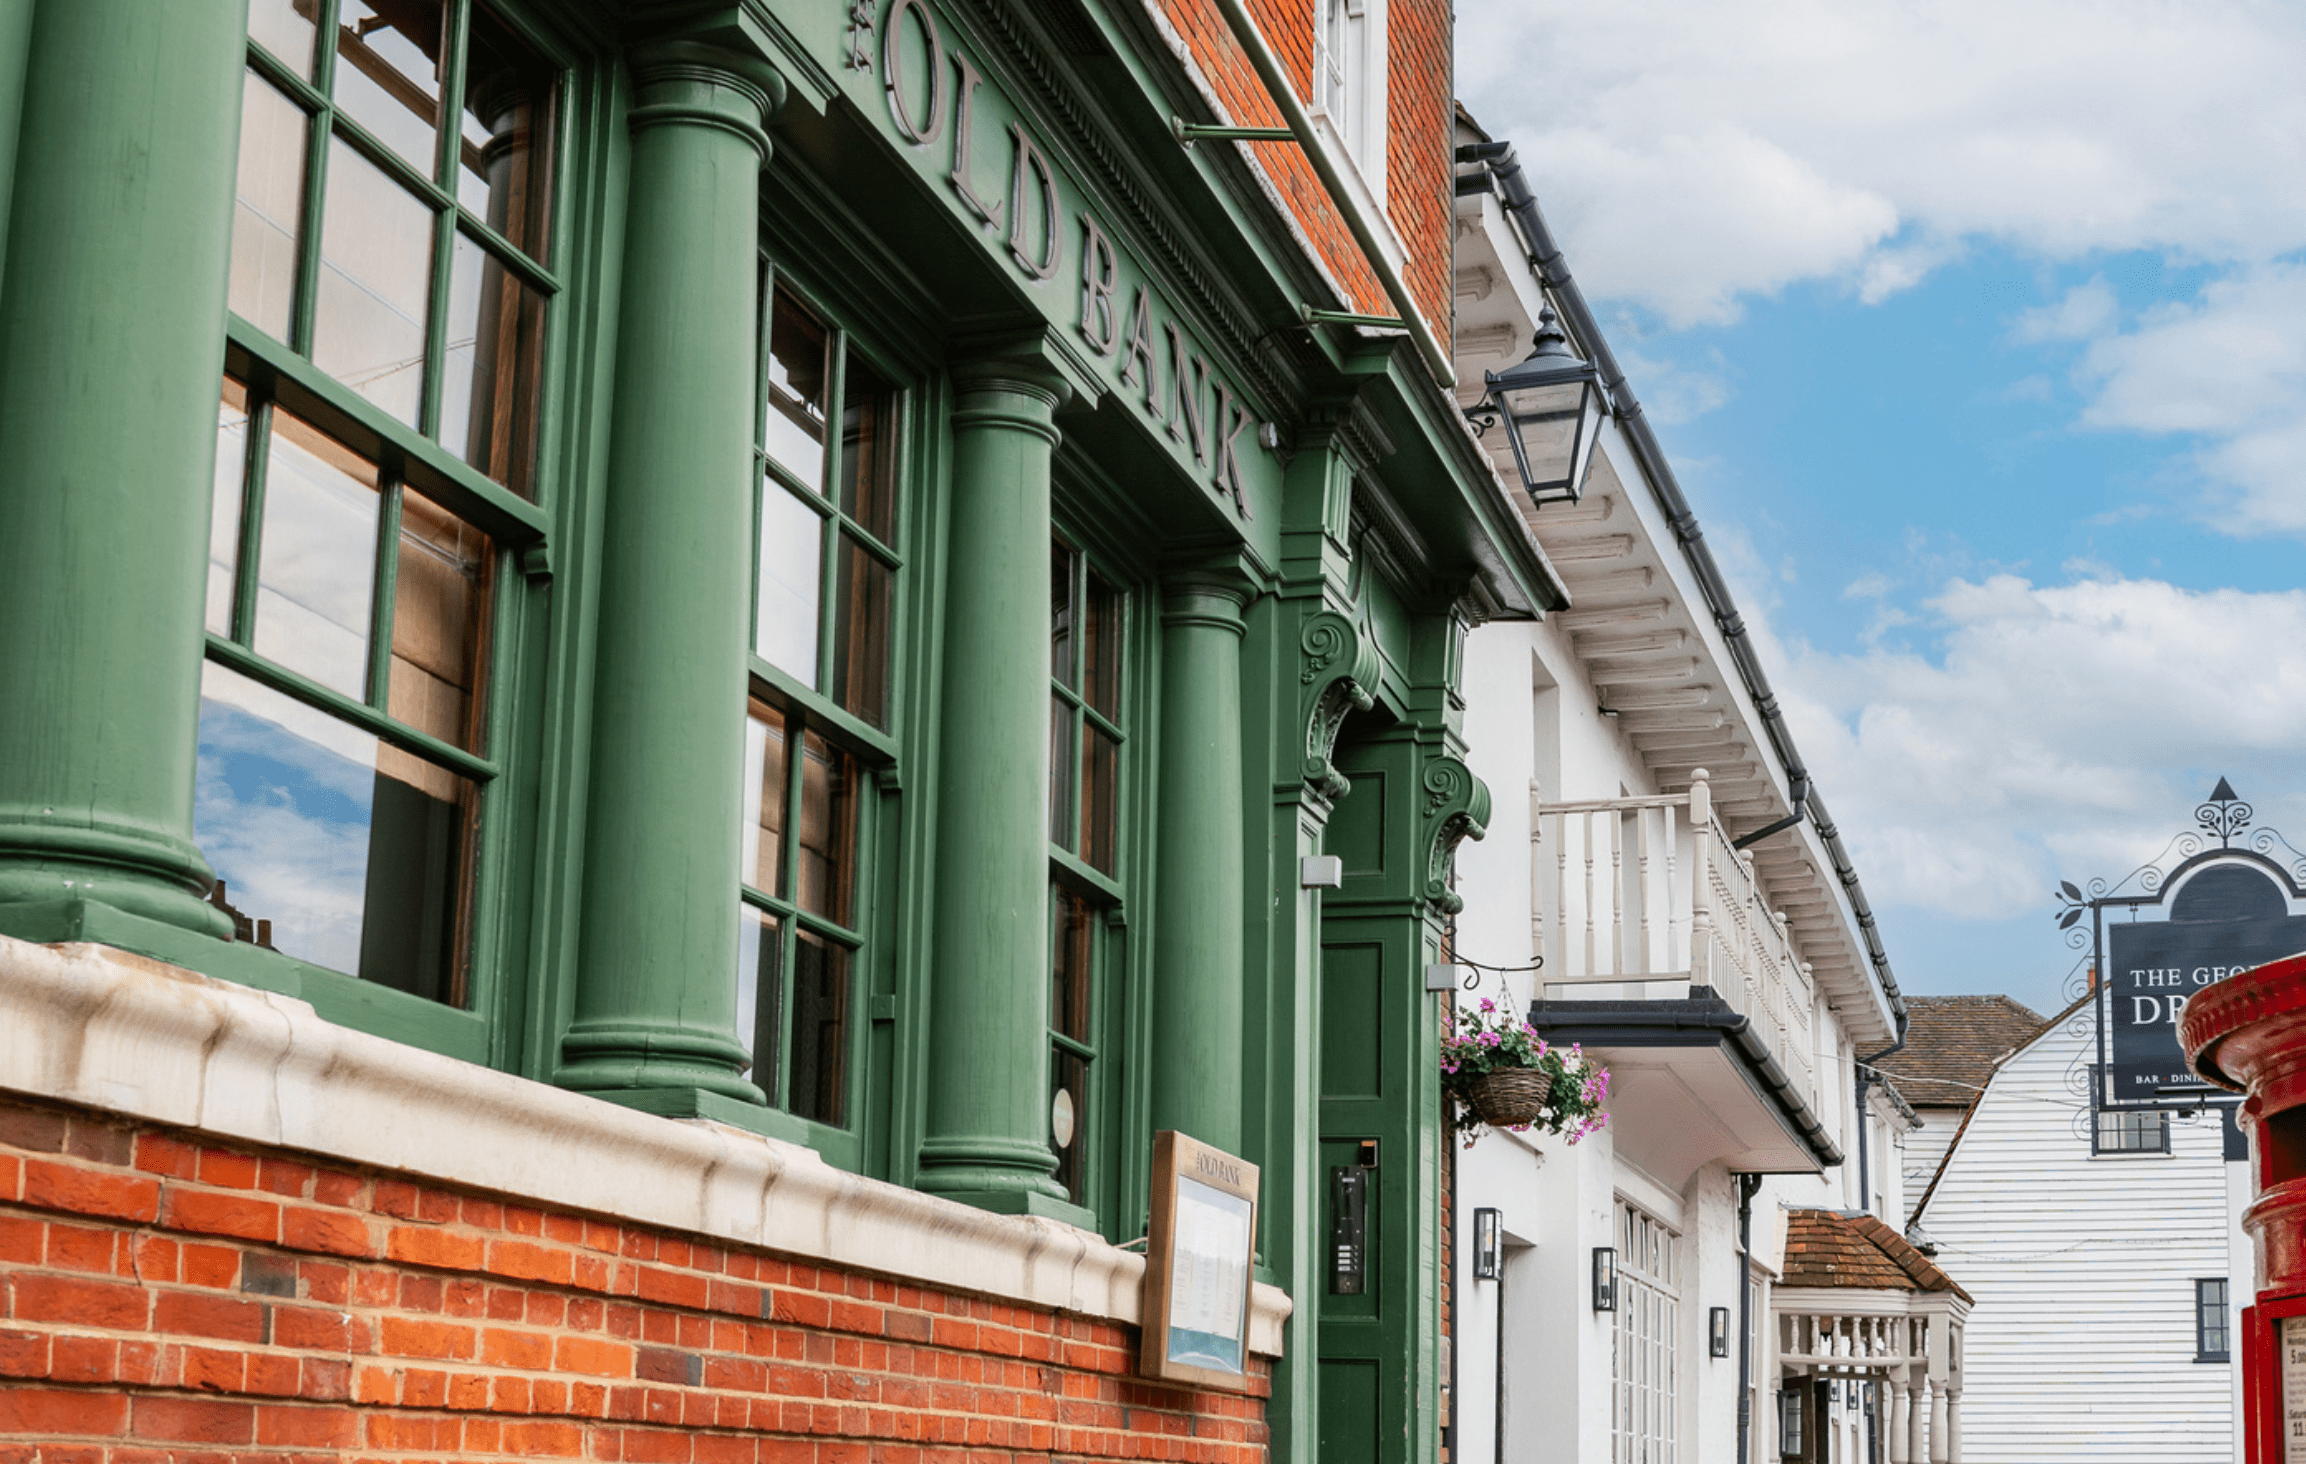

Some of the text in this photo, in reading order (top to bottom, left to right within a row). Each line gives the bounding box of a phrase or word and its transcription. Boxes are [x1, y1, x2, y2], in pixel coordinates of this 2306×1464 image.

[884, 0, 1254, 521] OLD BANK
[2129, 968, 2183, 988] THE
[2135, 1074, 2160, 1085] BAR
